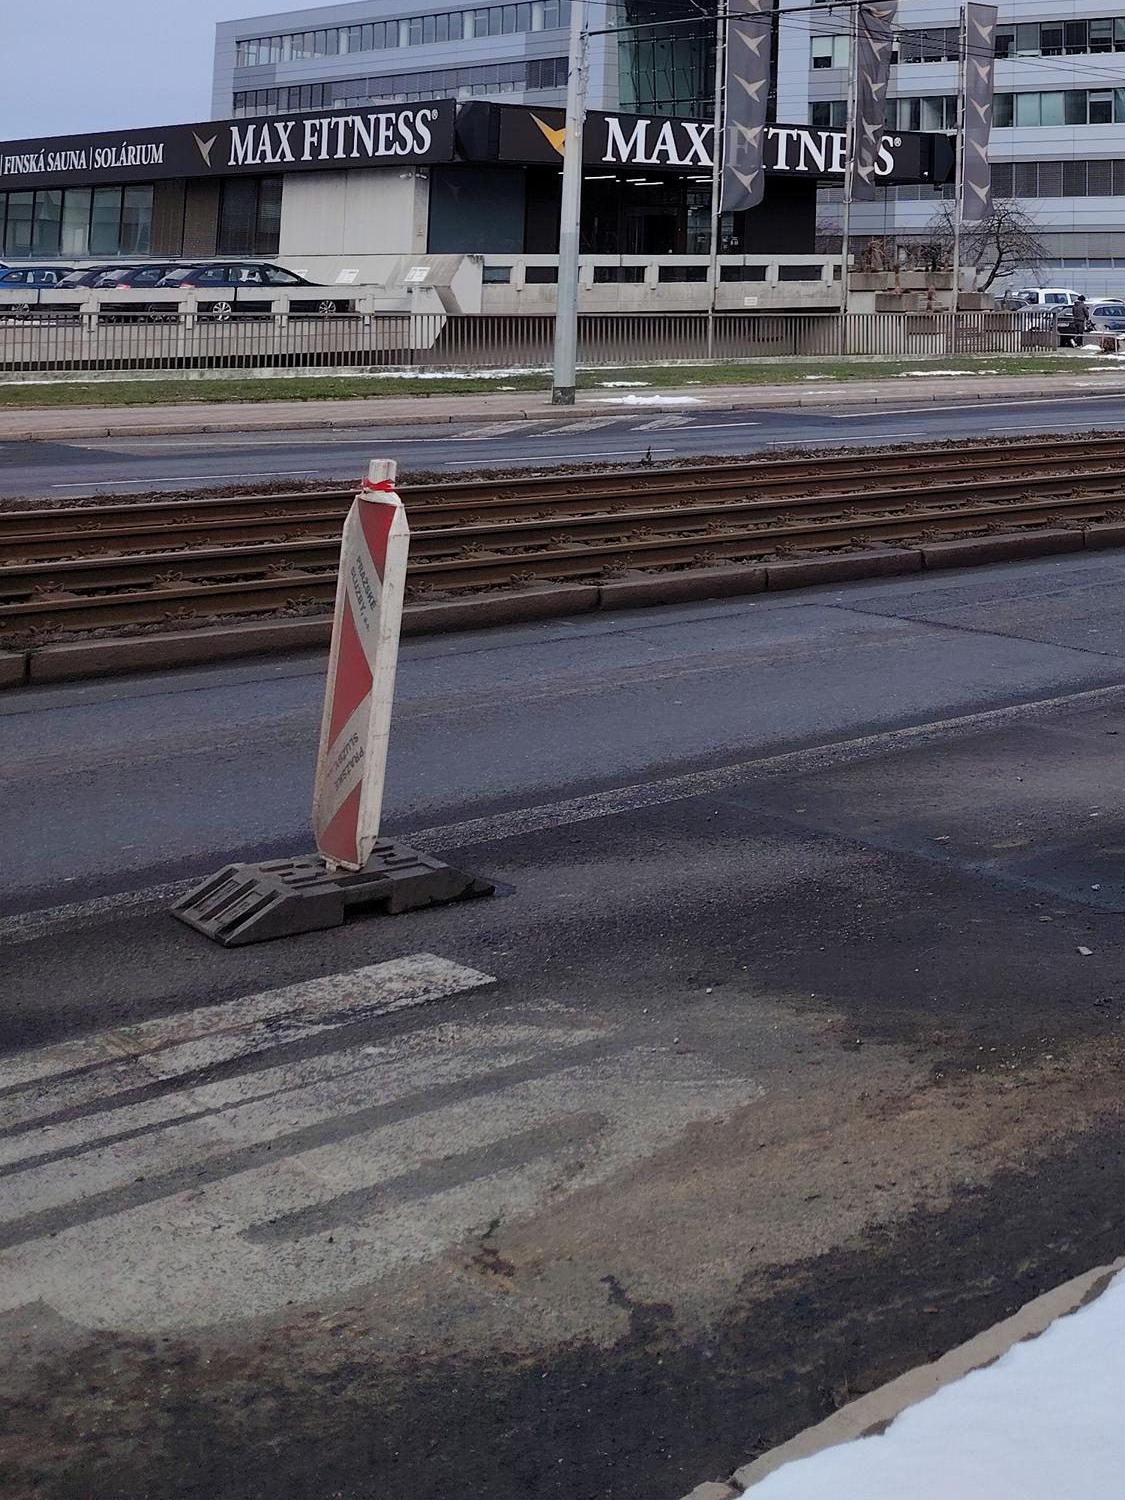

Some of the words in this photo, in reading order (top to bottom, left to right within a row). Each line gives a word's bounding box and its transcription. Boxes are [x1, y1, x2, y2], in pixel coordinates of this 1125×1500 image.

[3, 148, 46, 175] FINSKÁ
[46, 149, 88, 172] SAUNA
[93, 141, 164, 169] SOLÁRIUM
[227, 121, 296, 166] MAX
[602, 117, 715, 167] MAX
